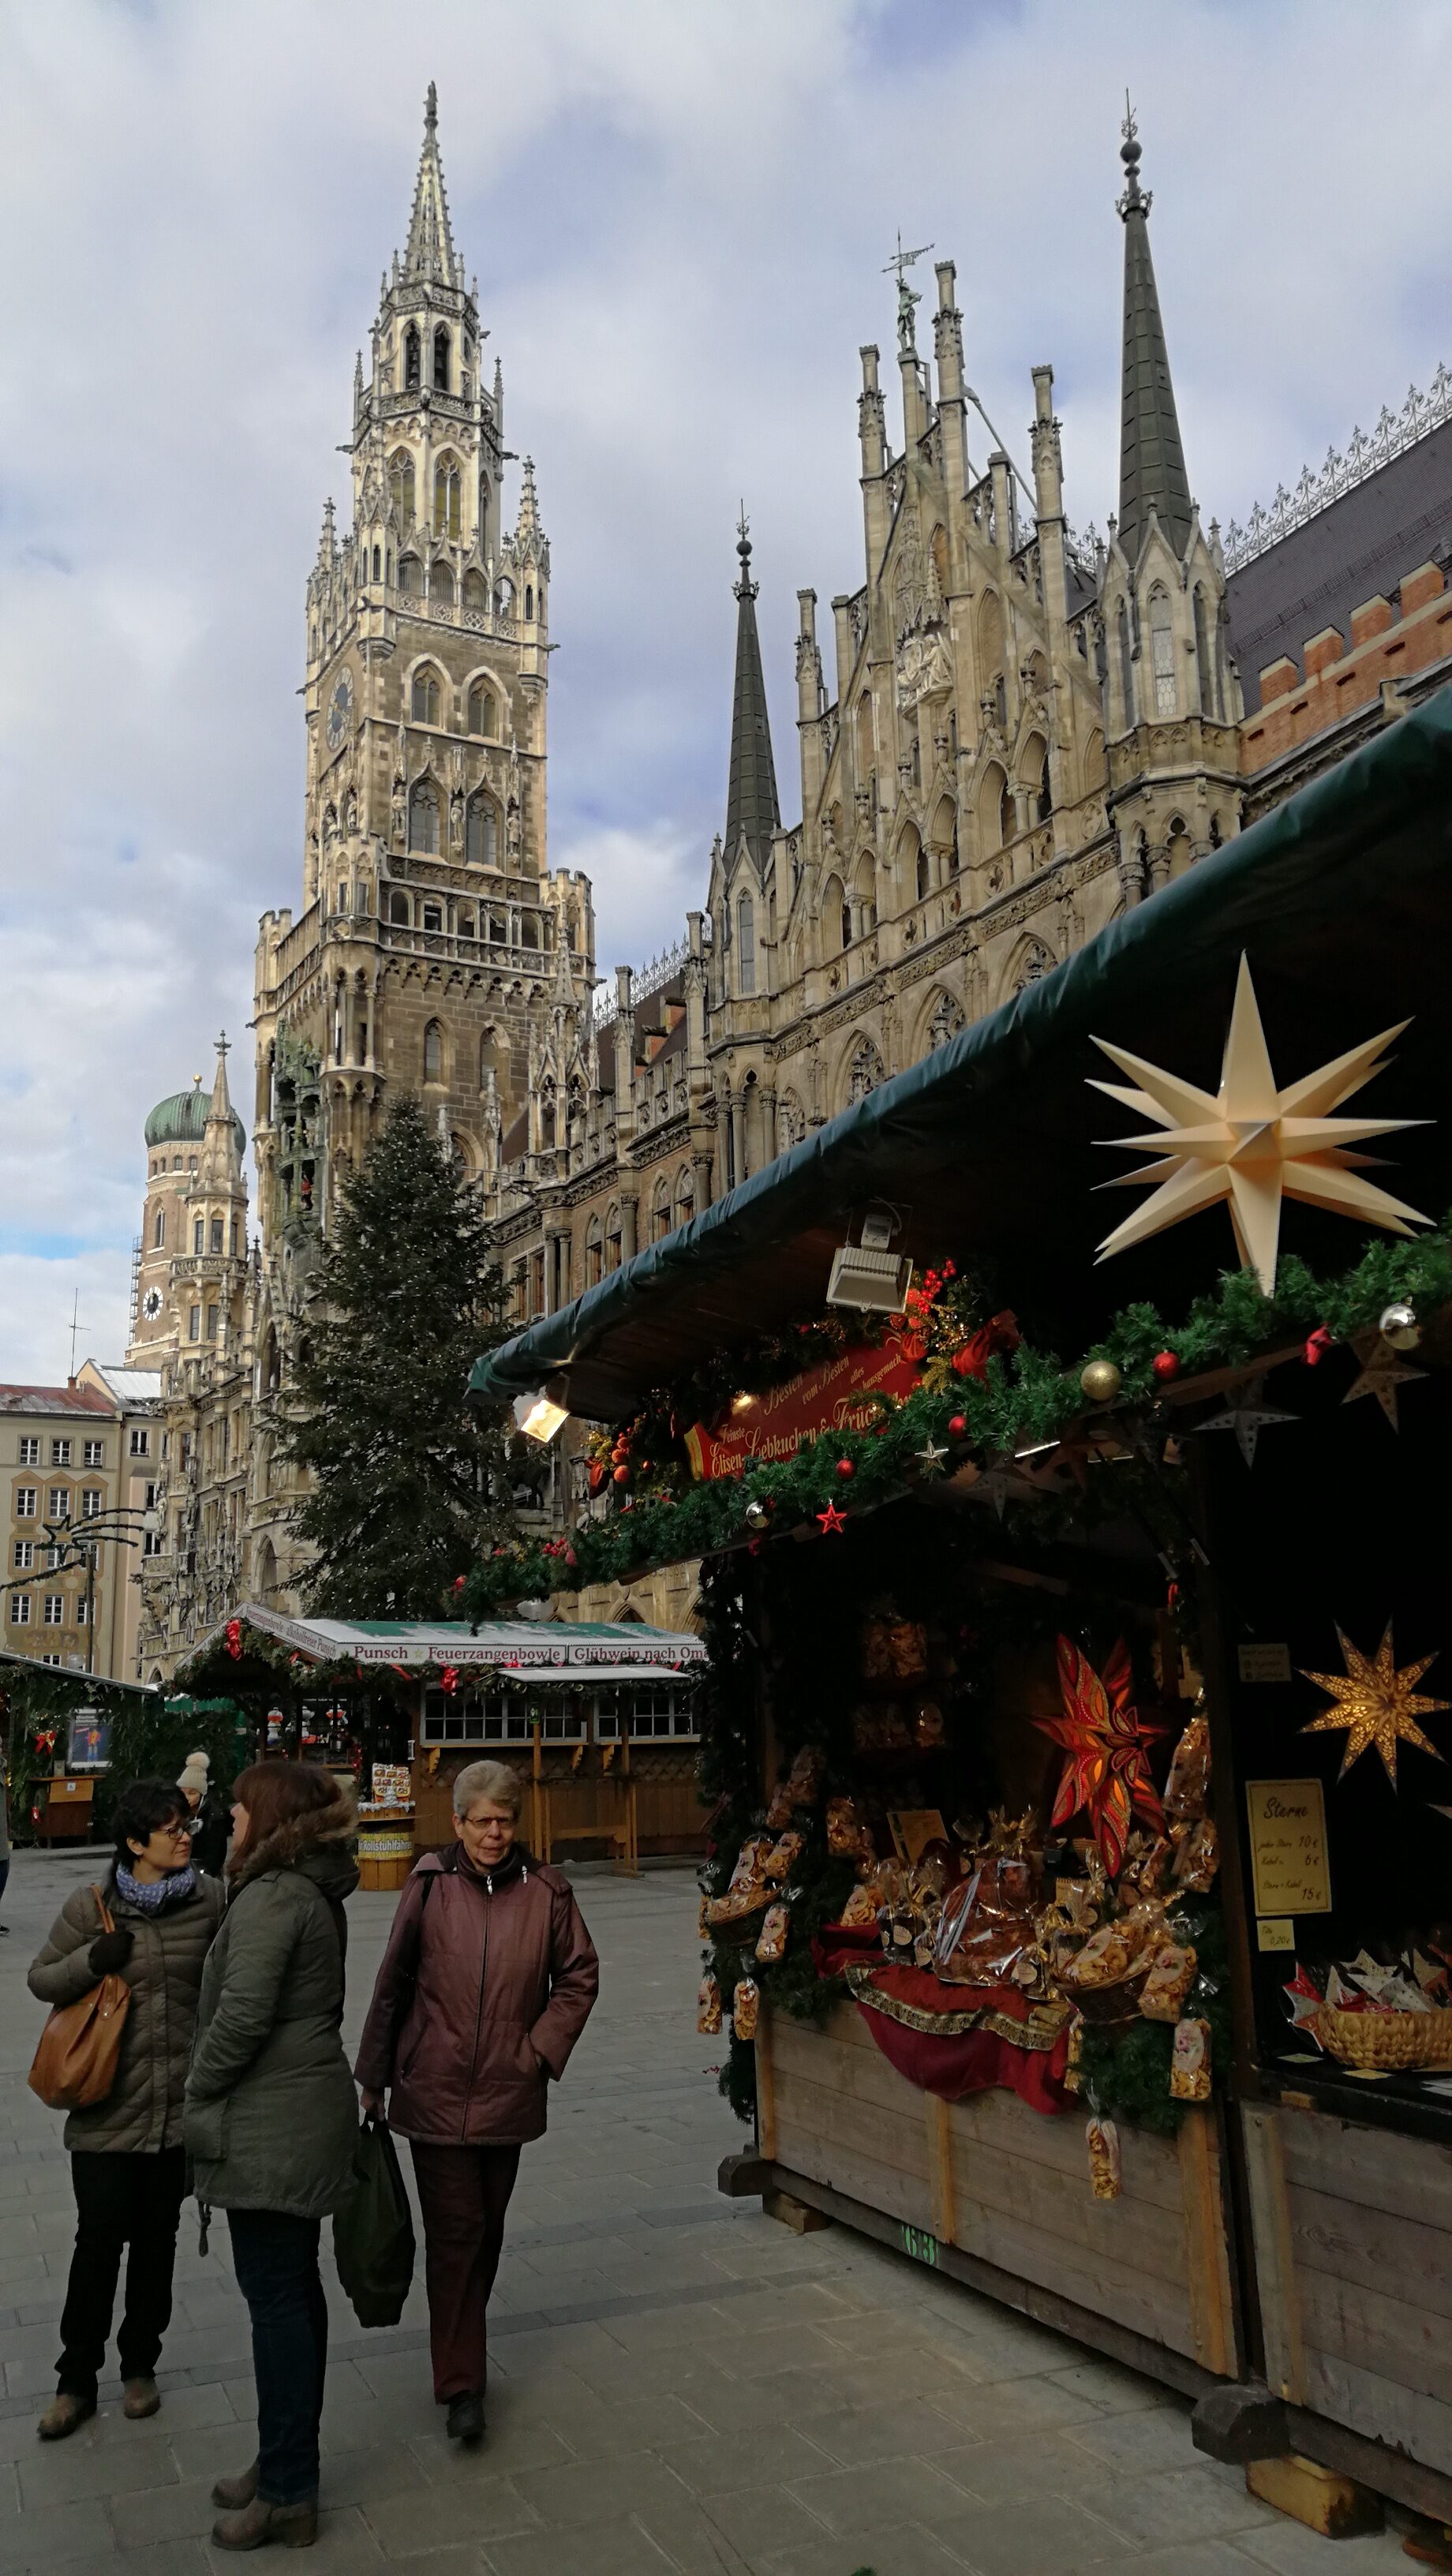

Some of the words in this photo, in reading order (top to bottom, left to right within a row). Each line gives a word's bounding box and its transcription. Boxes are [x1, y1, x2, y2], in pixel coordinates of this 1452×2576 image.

[802, 1383, 818, 1405] vom
[818, 1355, 850, 1391] Besten
[850, 1366, 864, 1384] alles
[862, 1353, 903, 1390] hausgemach
[720, 1423, 745, 1446] Feinste
[316, 1638, 336, 1658] Punsch
[354, 1646, 408, 1659] Punsch
[428, 1646, 560, 1663] Feuerzangenbowle
[574, 1646, 640, 1660] Glühwein
[644, 1646, 675, 1660] nach
[1263, 1797, 1308, 1818] Sterne
